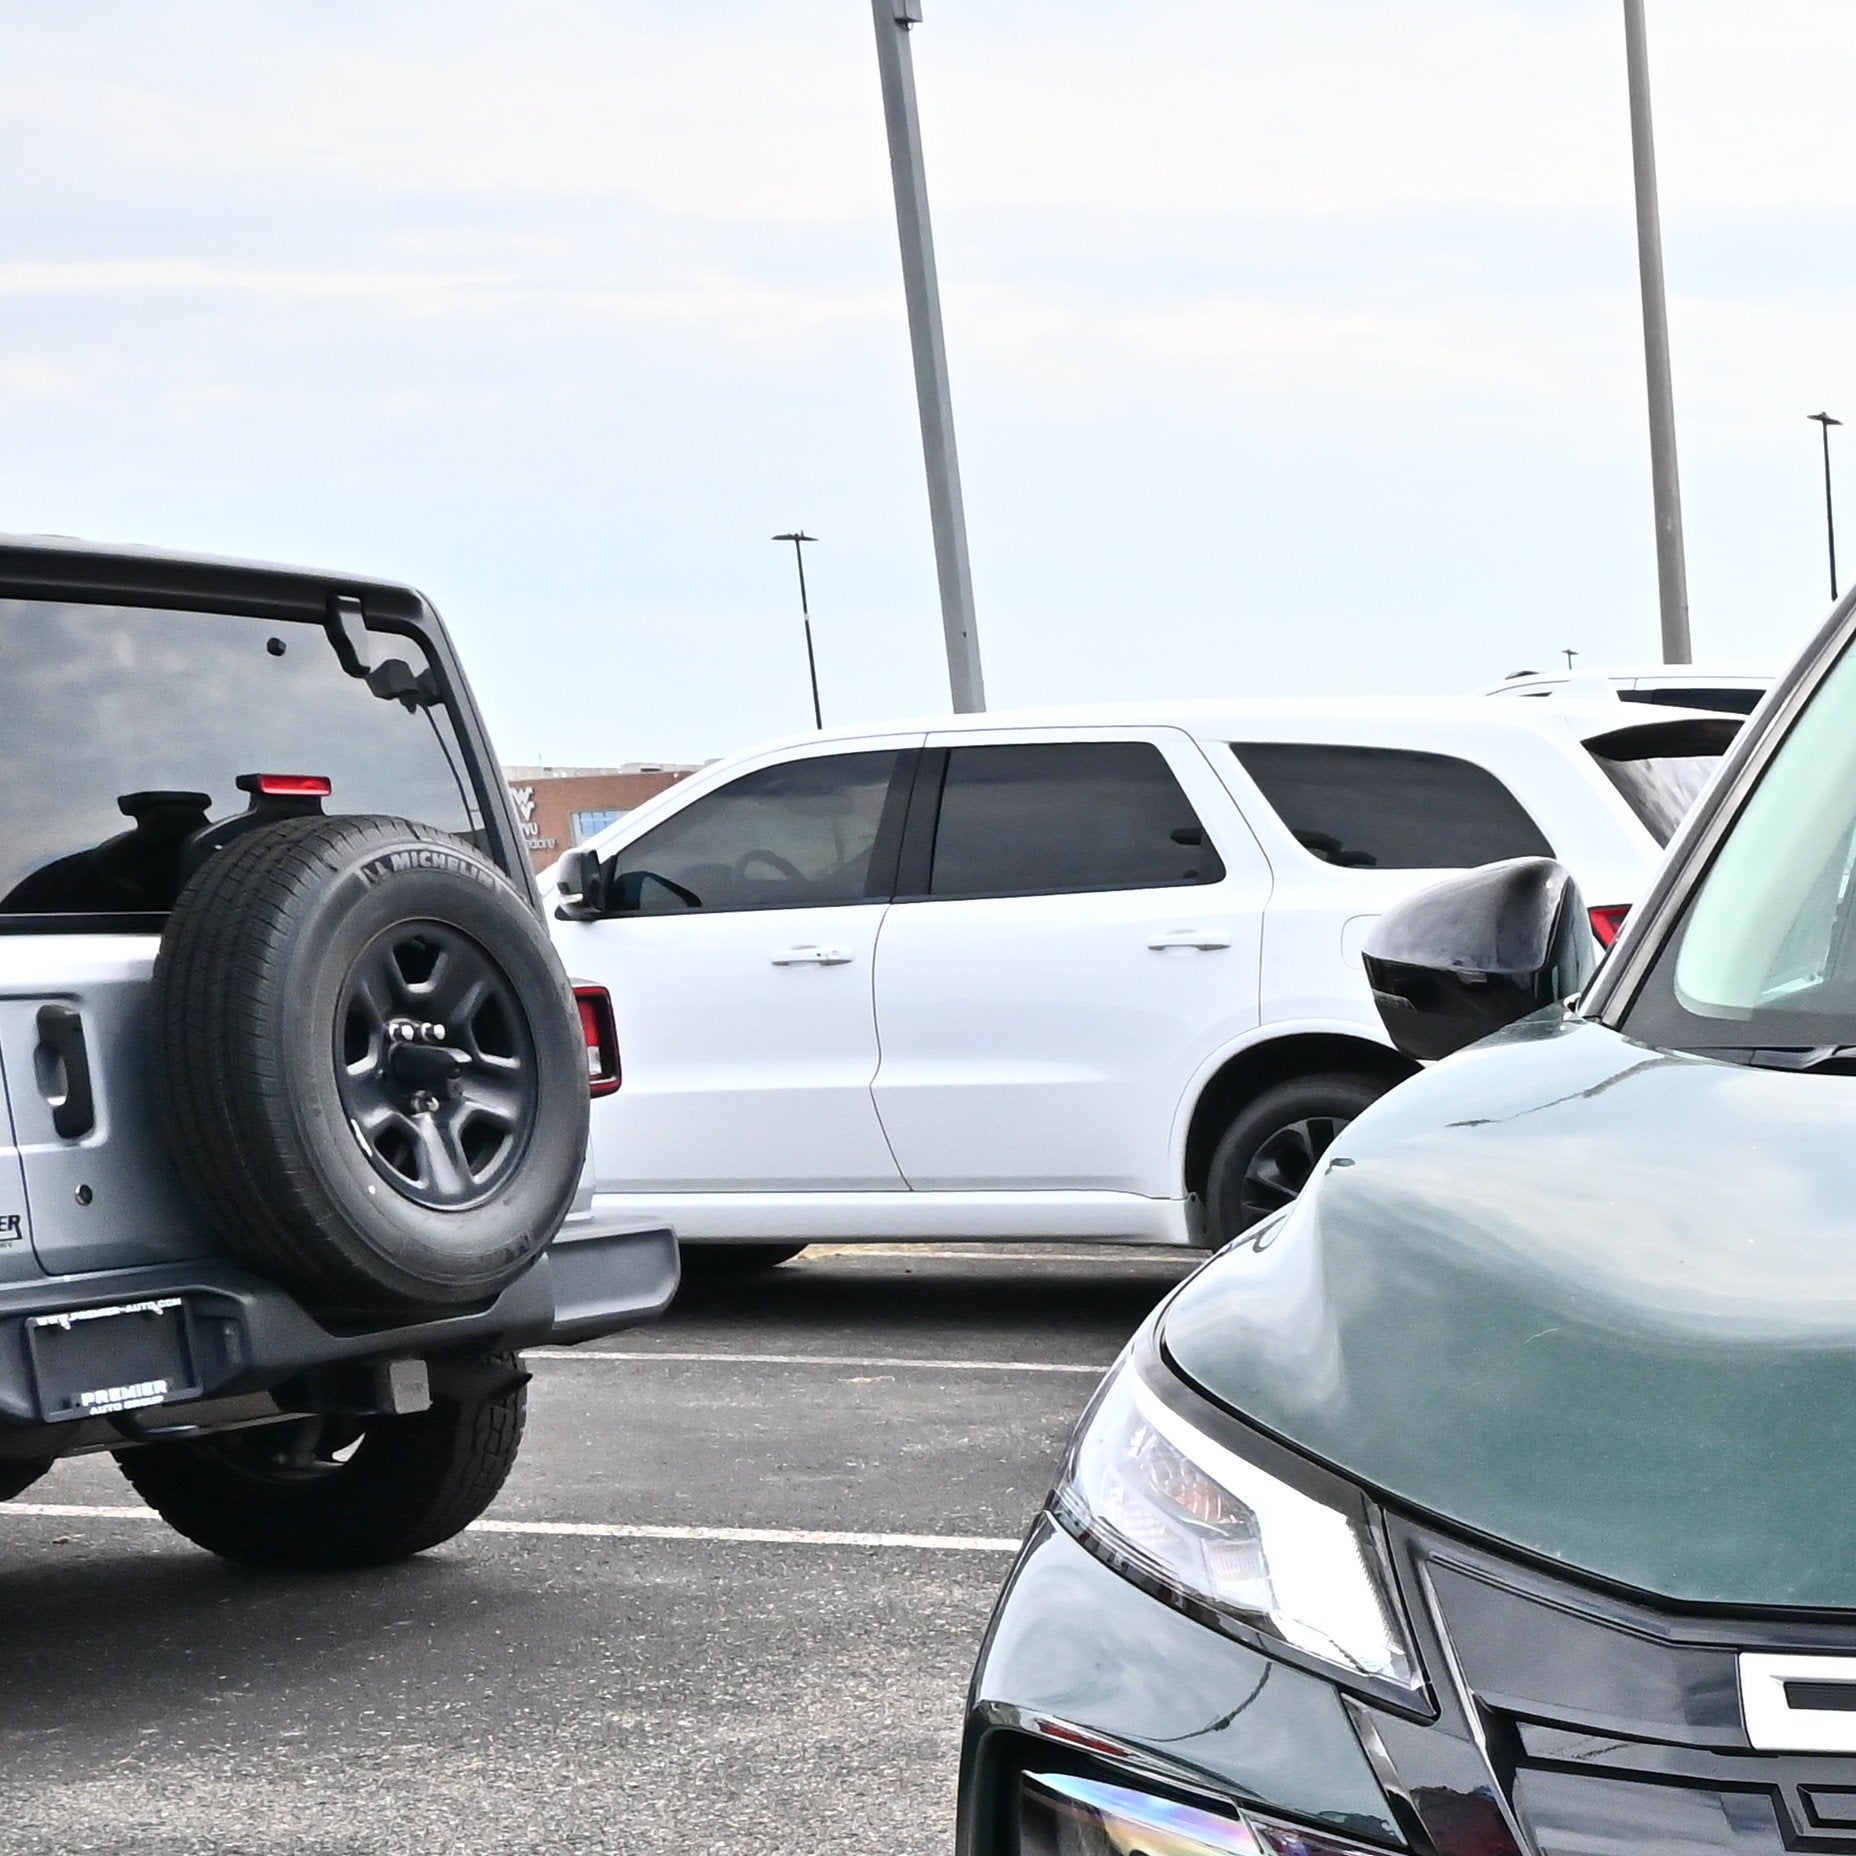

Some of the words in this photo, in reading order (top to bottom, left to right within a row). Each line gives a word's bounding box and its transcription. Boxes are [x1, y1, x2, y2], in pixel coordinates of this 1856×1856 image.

[390, 850, 495, 889] MICHELIN
[81, 1379, 168, 1406] PREMIER
[89, 1402, 122, 1416] AUTO
